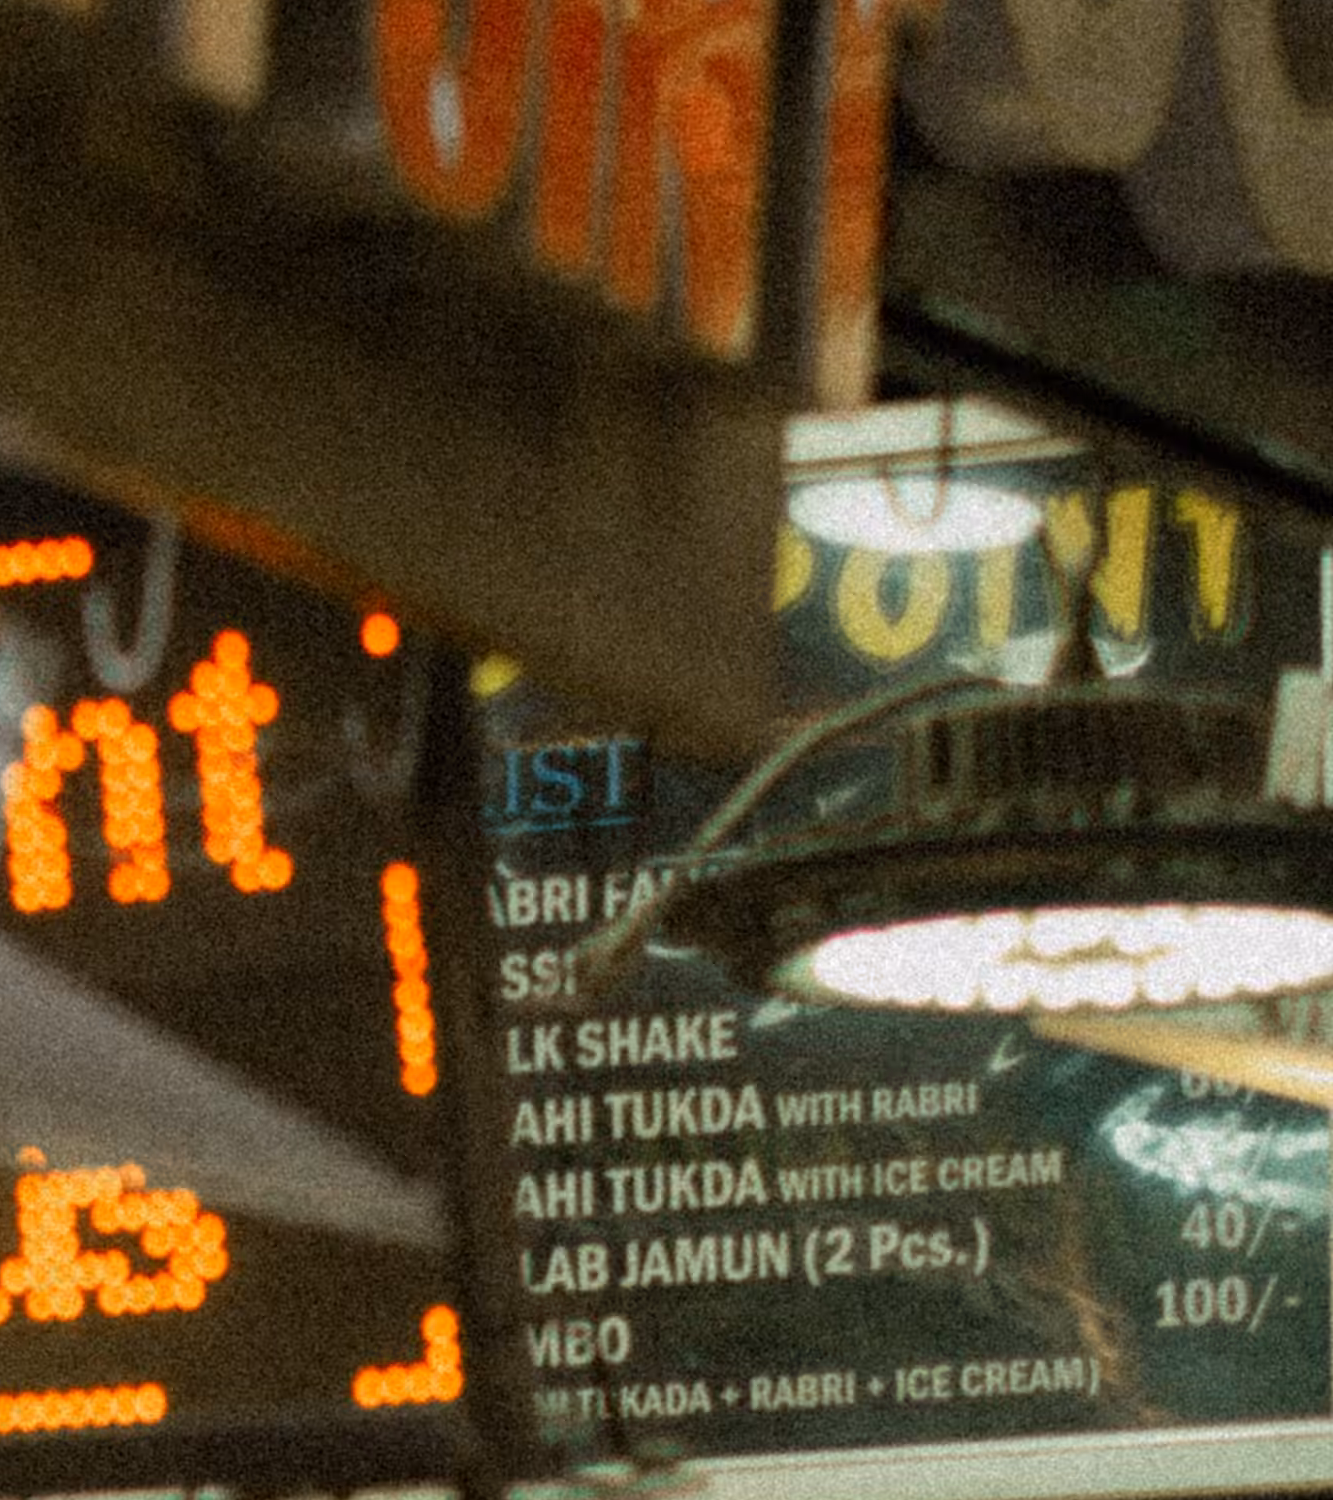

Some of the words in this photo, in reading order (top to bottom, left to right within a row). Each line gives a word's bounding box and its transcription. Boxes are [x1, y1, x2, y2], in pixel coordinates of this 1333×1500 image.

[576, 1011, 739, 1072] SHAKE
[603, 1083, 766, 1140] TUKDA
[777, 1090, 862, 1128] WITH
[870, 1082, 980, 1120] RABRI
[607, 1158, 767, 1214] TUKDA
[779, 1164, 863, 1202] WITH
[872, 1157, 929, 1197] ICE
[936, 1150, 1063, 1192] CREAM
[620, 1230, 790, 1290] JAMUN
[802, 1228, 855, 1286] (2
[870, 1216, 989, 1276] Pcs.)
[1155, 1273, 1301, 1334] 100/-
[750, 1372, 856, 1414] RABRI
[896, 1366, 952, 1402] ICE
[959, 1356, 1101, 1402] CREAM)
